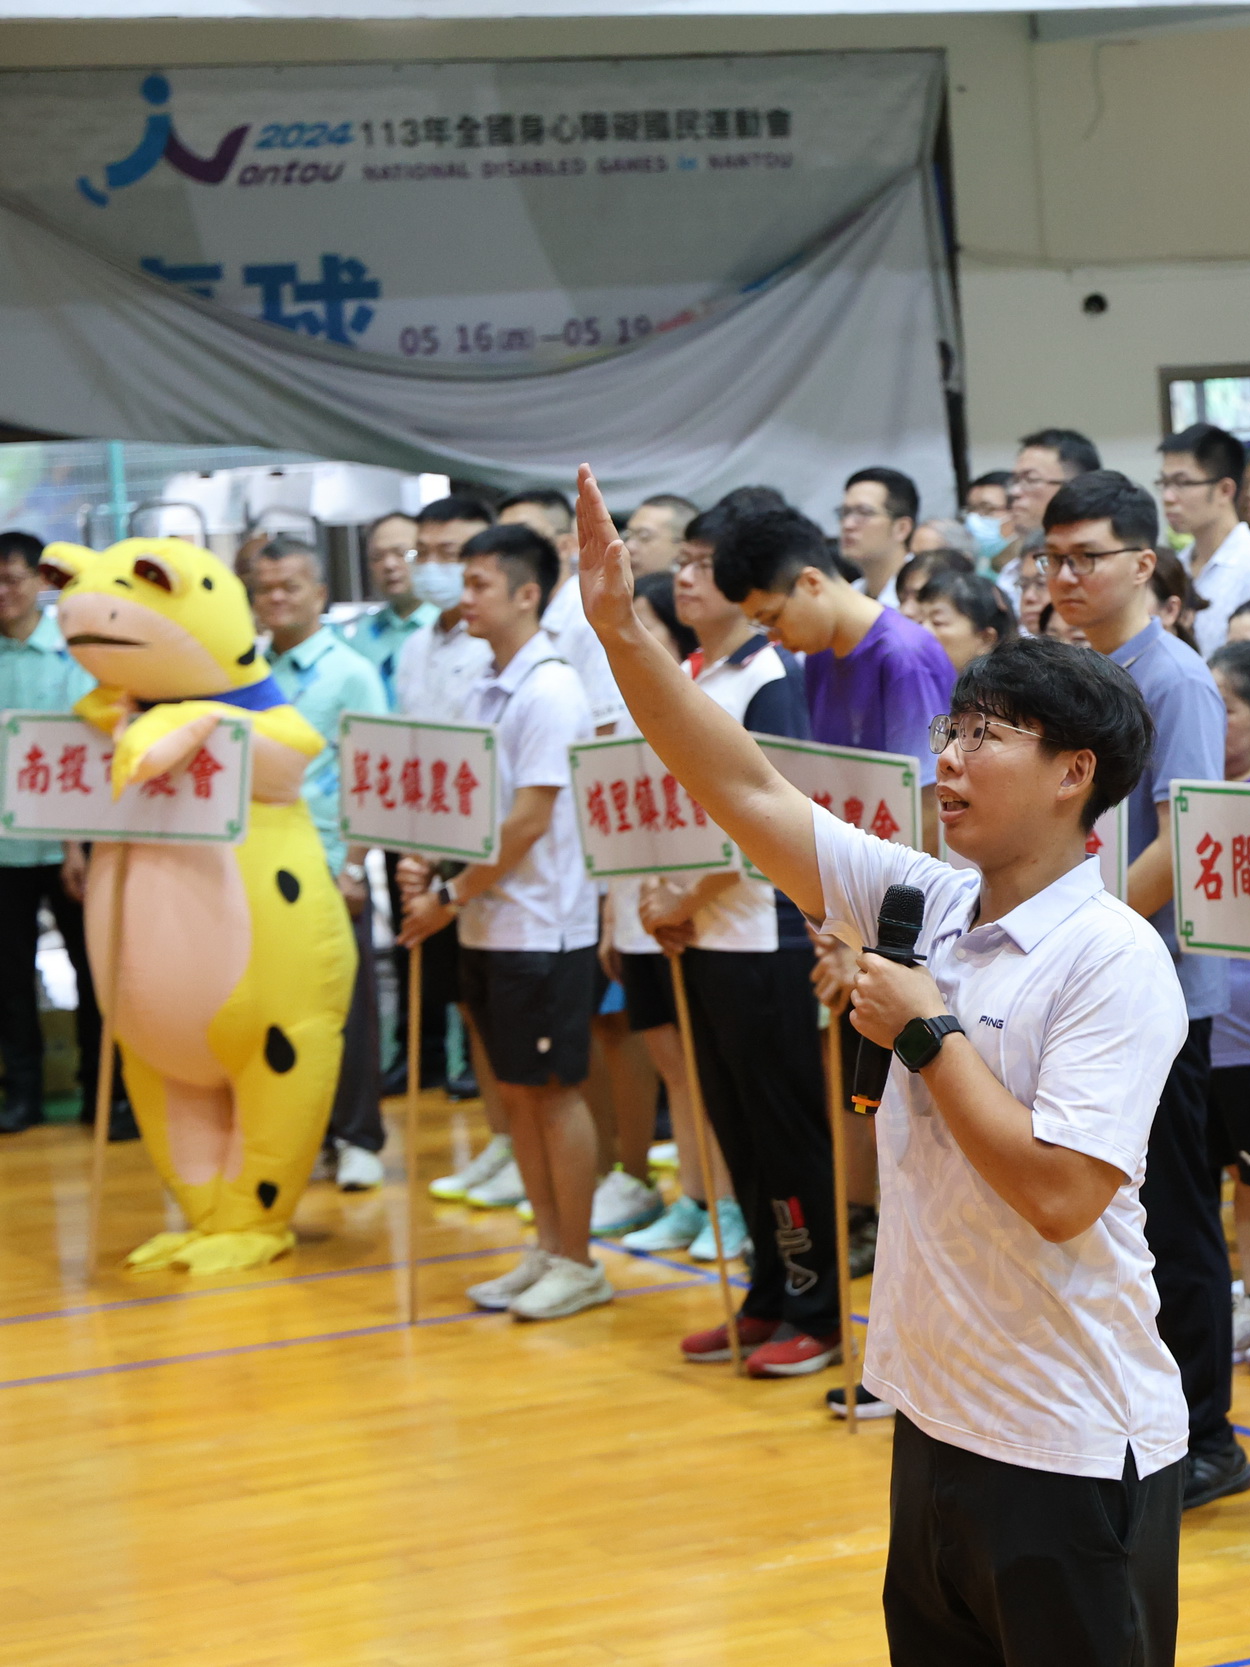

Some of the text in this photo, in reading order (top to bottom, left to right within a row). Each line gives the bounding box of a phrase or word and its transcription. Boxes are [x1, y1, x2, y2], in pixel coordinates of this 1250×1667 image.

[256, 120, 355, 149] 2024
[400, 324, 440, 355] 05
[456, 321, 493, 354] 16
[979, 1015, 1004, 1029] PING
[770, 1196, 818, 1297] FILA
